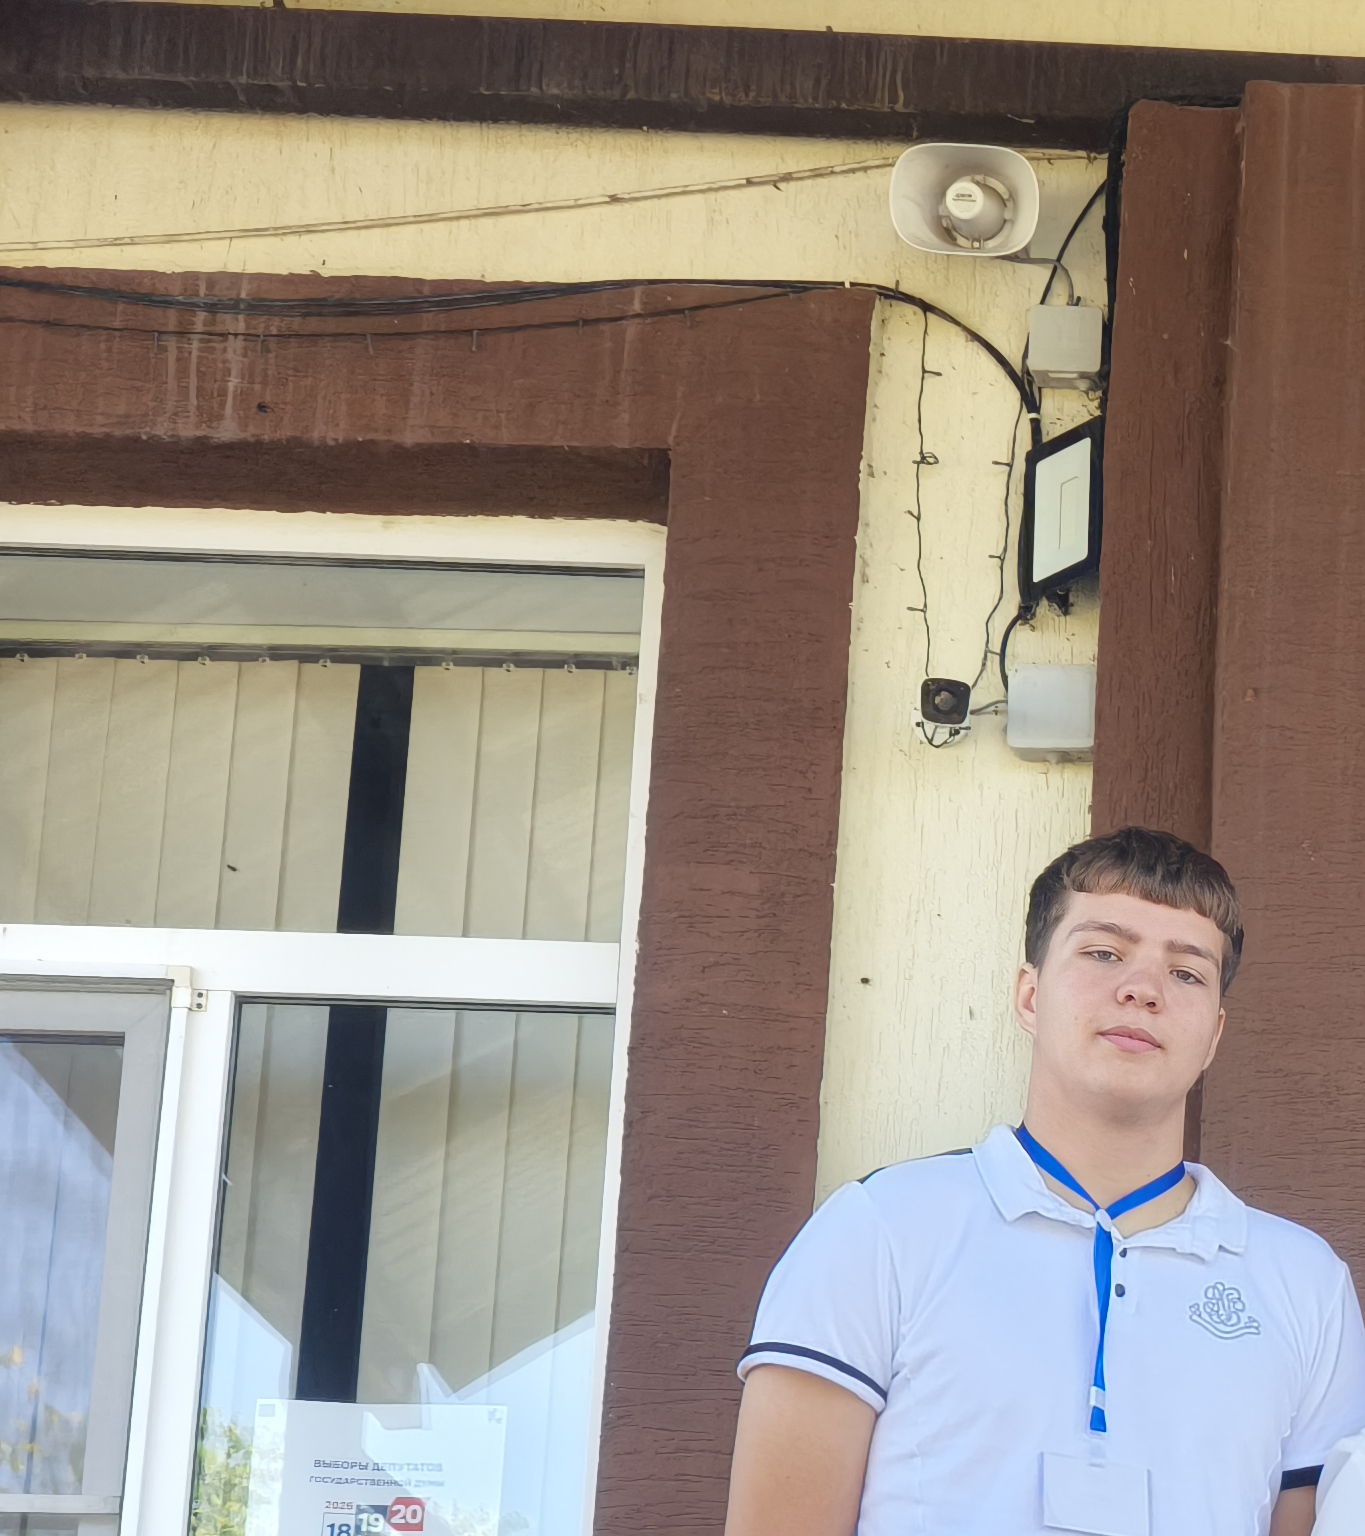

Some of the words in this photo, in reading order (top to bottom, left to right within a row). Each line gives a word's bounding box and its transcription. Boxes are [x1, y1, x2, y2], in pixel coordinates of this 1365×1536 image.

[313, 1459, 369, 1471] ВЫБОРЫ
[358, 1512, 385, 1533] 19
[390, 1504, 423, 1524] 20
